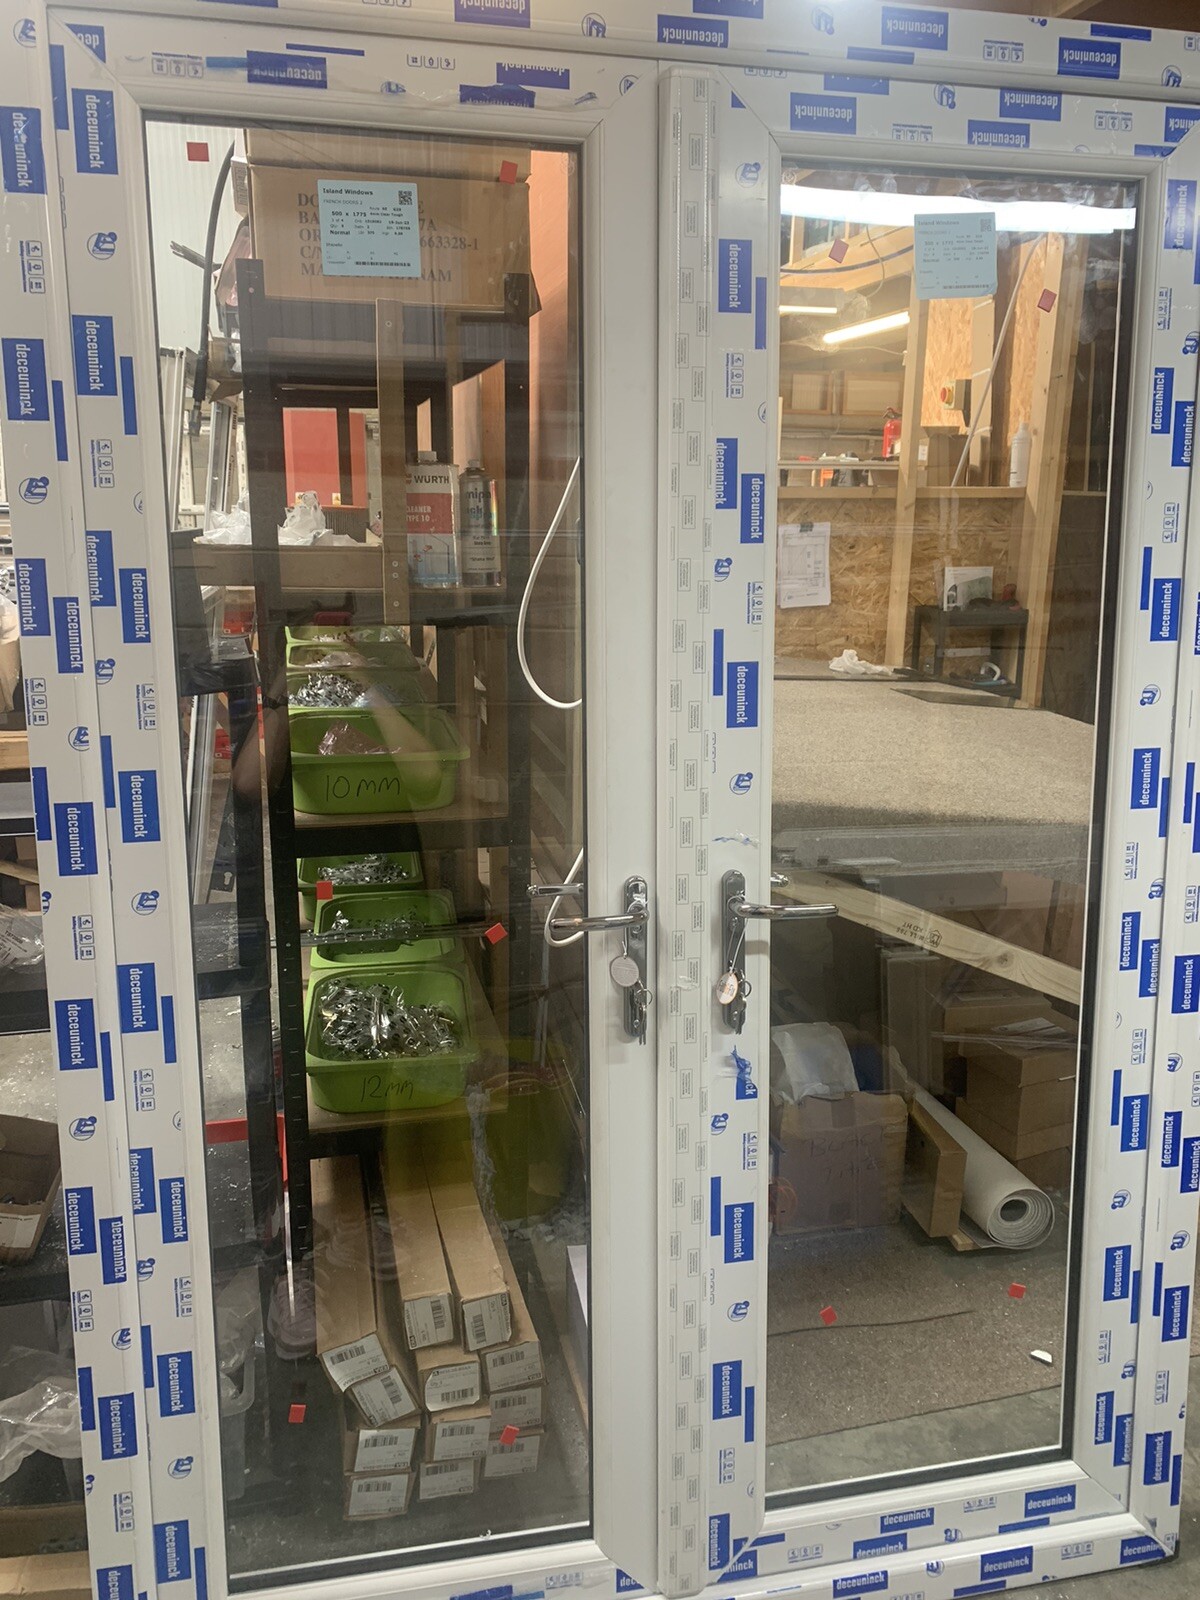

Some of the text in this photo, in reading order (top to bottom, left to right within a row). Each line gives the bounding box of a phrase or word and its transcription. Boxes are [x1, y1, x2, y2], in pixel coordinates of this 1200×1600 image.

[662, 27, 725, 47] deceuninck
[886, 19, 944, 37] deceuninck
[1063, 48, 1118, 67] deceuninck
[794, 104, 853, 121] deceuninck
[1004, 91, 1058, 109] deceuninck
[85, 94, 105, 168] deceuninck
[972, 131, 1026, 147] deceuninck
[729, 243, 741, 308] deceuninck
[15, 343, 36, 416] deceuninck
[85, 320, 104, 391] deceuninck
[1152, 372, 1165, 430] deceuninck
[1181, 405, 1195, 463] deceuninck
[716, 442, 727, 505] deceuninck
[751, 477, 763, 539] deceuninck
[86, 535, 104, 602] deceuninck
[18, 563, 37, 631] deceuninck
[131, 572, 150, 639] deceuninck
[1159, 582, 1173, 638] deceuninck
[66, 601, 82, 668] deceuninck
[736, 665, 748, 724] deceuninck
[1139, 752, 1153, 806] deceuninck
[130, 774, 149, 838] deceuninck
[66, 807, 86, 871] deceuninck
[1120, 915, 1133, 968] deceuninck
[1148, 942, 1160, 994] deceuninck
[129, 967, 144, 1028] deceuninck
[1181, 958, 1194, 1010] deceuninck
[67, 1003, 85, 1065] deceuninck
[1129, 1098, 1141, 1148] deceuninck
[1161, 1115, 1174, 1165] deceuninck
[1188, 1139, 1200, 1189] deceuninck
[67, 1192, 84, 1250] deceuninck
[170, 1181, 186, 1238] deceuninck
[733, 1206, 745, 1259] deceuninck
[111, 1220, 125, 1279] deceuninck
[1111, 1249, 1123, 1297] deceuninck
[1170, 1290, 1182, 1338] deceuninck
[168, 1356, 183, 1412] deceuninck
[721, 1364, 733, 1416] deceuninck
[110, 1398, 125, 1455] deceuninck
[1095, 1395, 1106, 1442] deceuninck
[1121, 1417, 1133, 1463] deceuninck
[1152, 1435, 1164, 1481] deceuninck
[883, 1509, 931, 1526] deceuninck
[1027, 1493, 1074, 1510] deceuninck
[165, 1525, 181, 1578] deceuninck
[709, 1518, 721, 1568] deceuninck
[856, 1541, 904, 1559] deceuninck
[983, 1555, 1030, 1573] deceuninck
[108, 1570, 122, 1600] deceu
[836, 1572, 885, 1590] deceuninck
